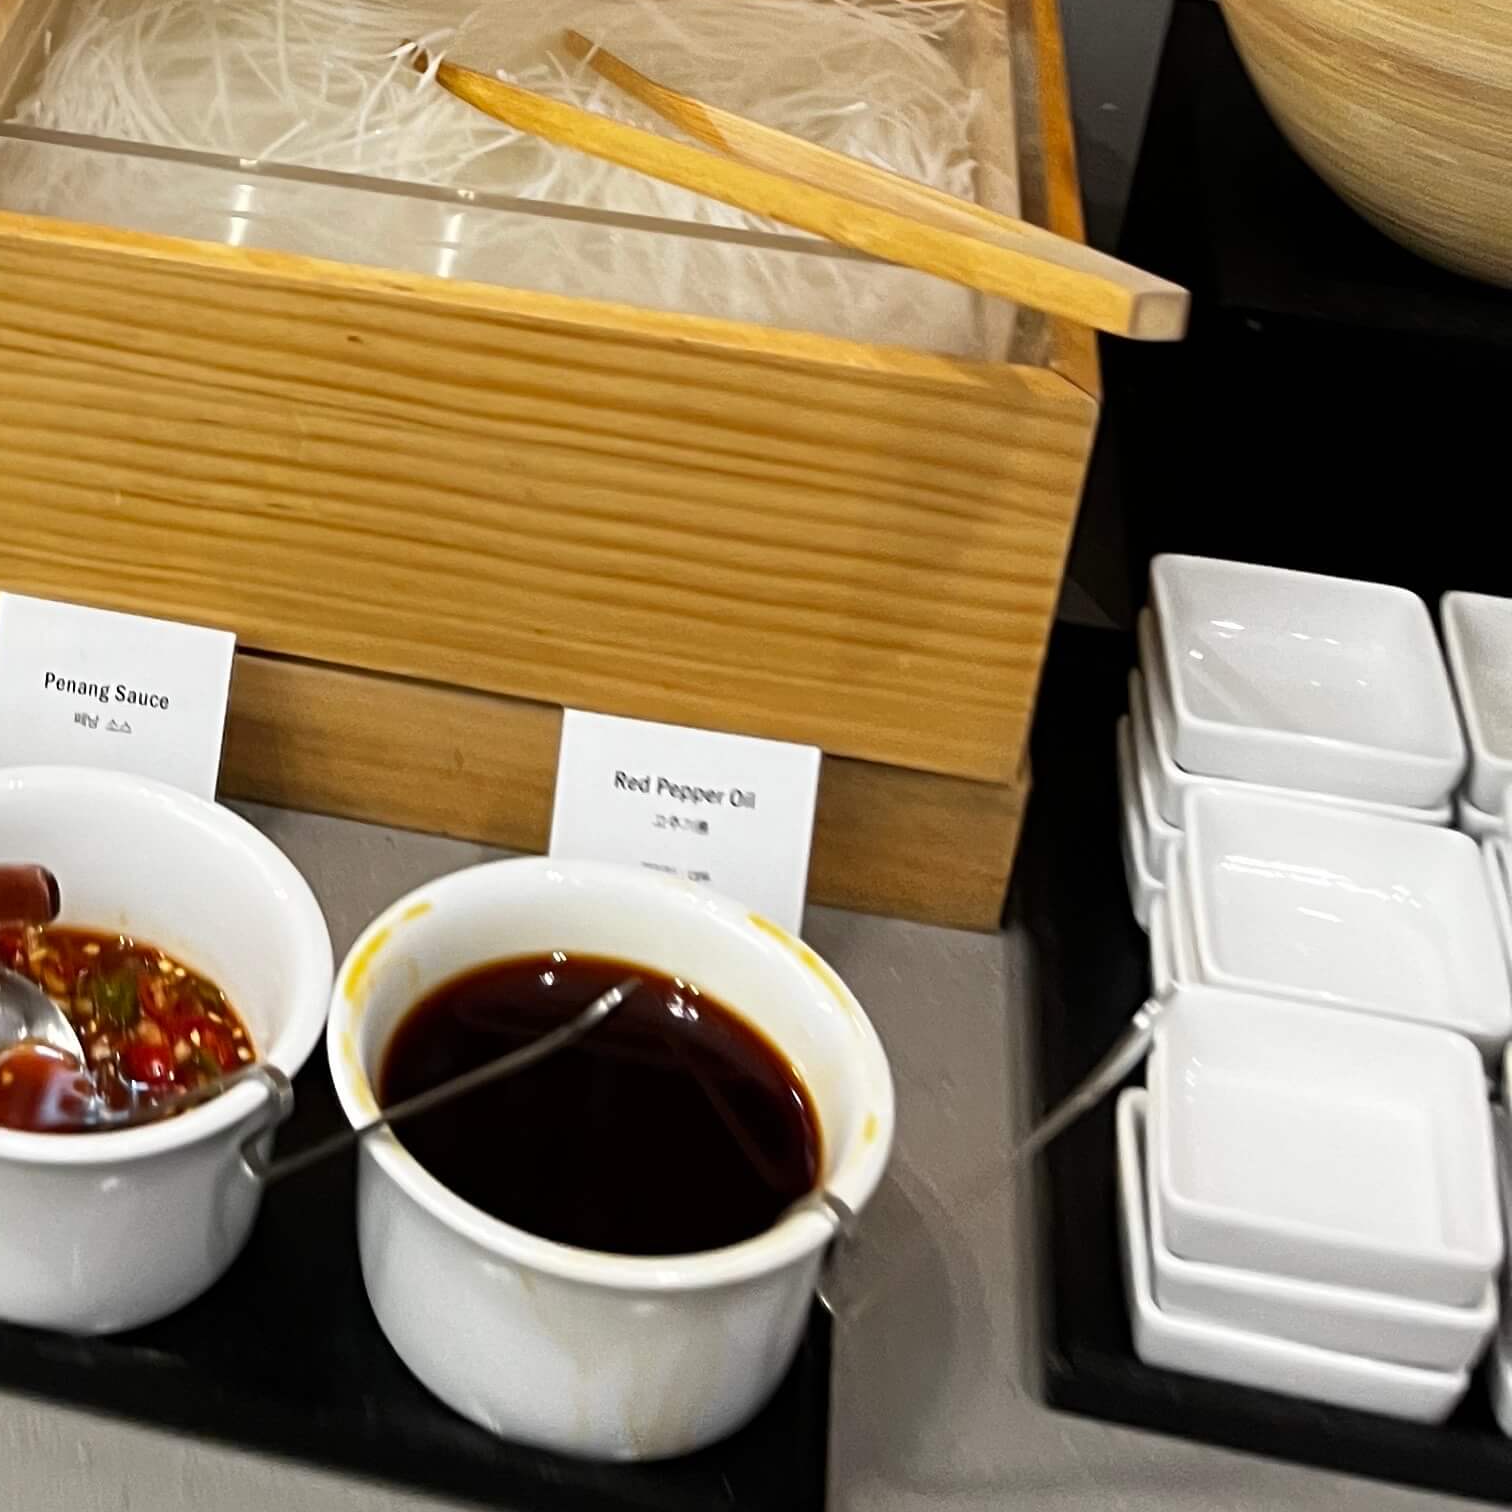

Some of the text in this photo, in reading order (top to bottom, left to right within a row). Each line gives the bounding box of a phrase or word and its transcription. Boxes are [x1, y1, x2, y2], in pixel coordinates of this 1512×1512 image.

[45, 671, 169, 710] Penang Sauce
[614, 770, 757, 810] Red Pepper Oil
